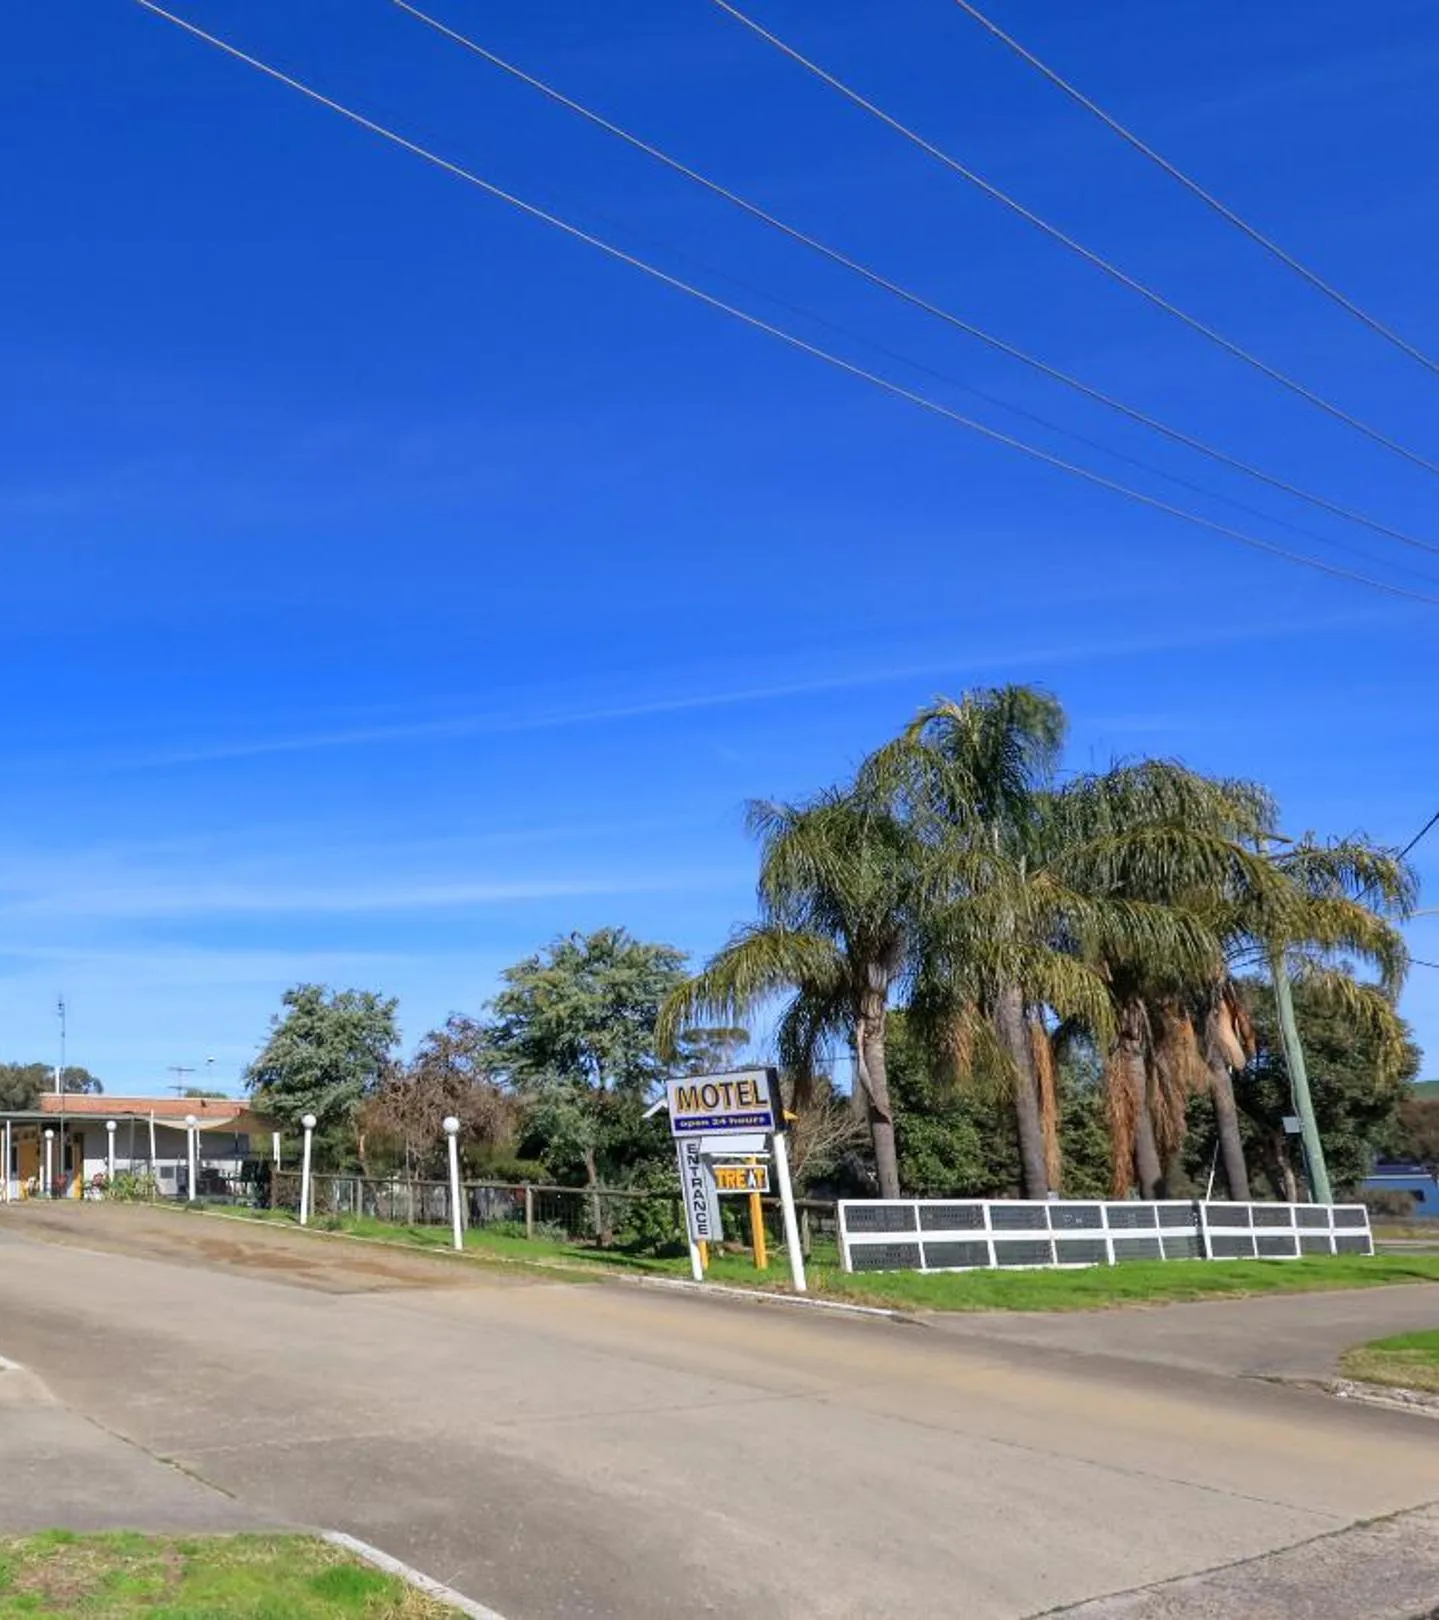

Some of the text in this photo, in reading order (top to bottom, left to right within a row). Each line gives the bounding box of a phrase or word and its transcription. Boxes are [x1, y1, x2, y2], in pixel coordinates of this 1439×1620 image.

[676, 1080, 767, 1112] MOTEL
[711, 1118, 727, 1126] 24
[686, 1143, 708, 1236] ENTRANCE
